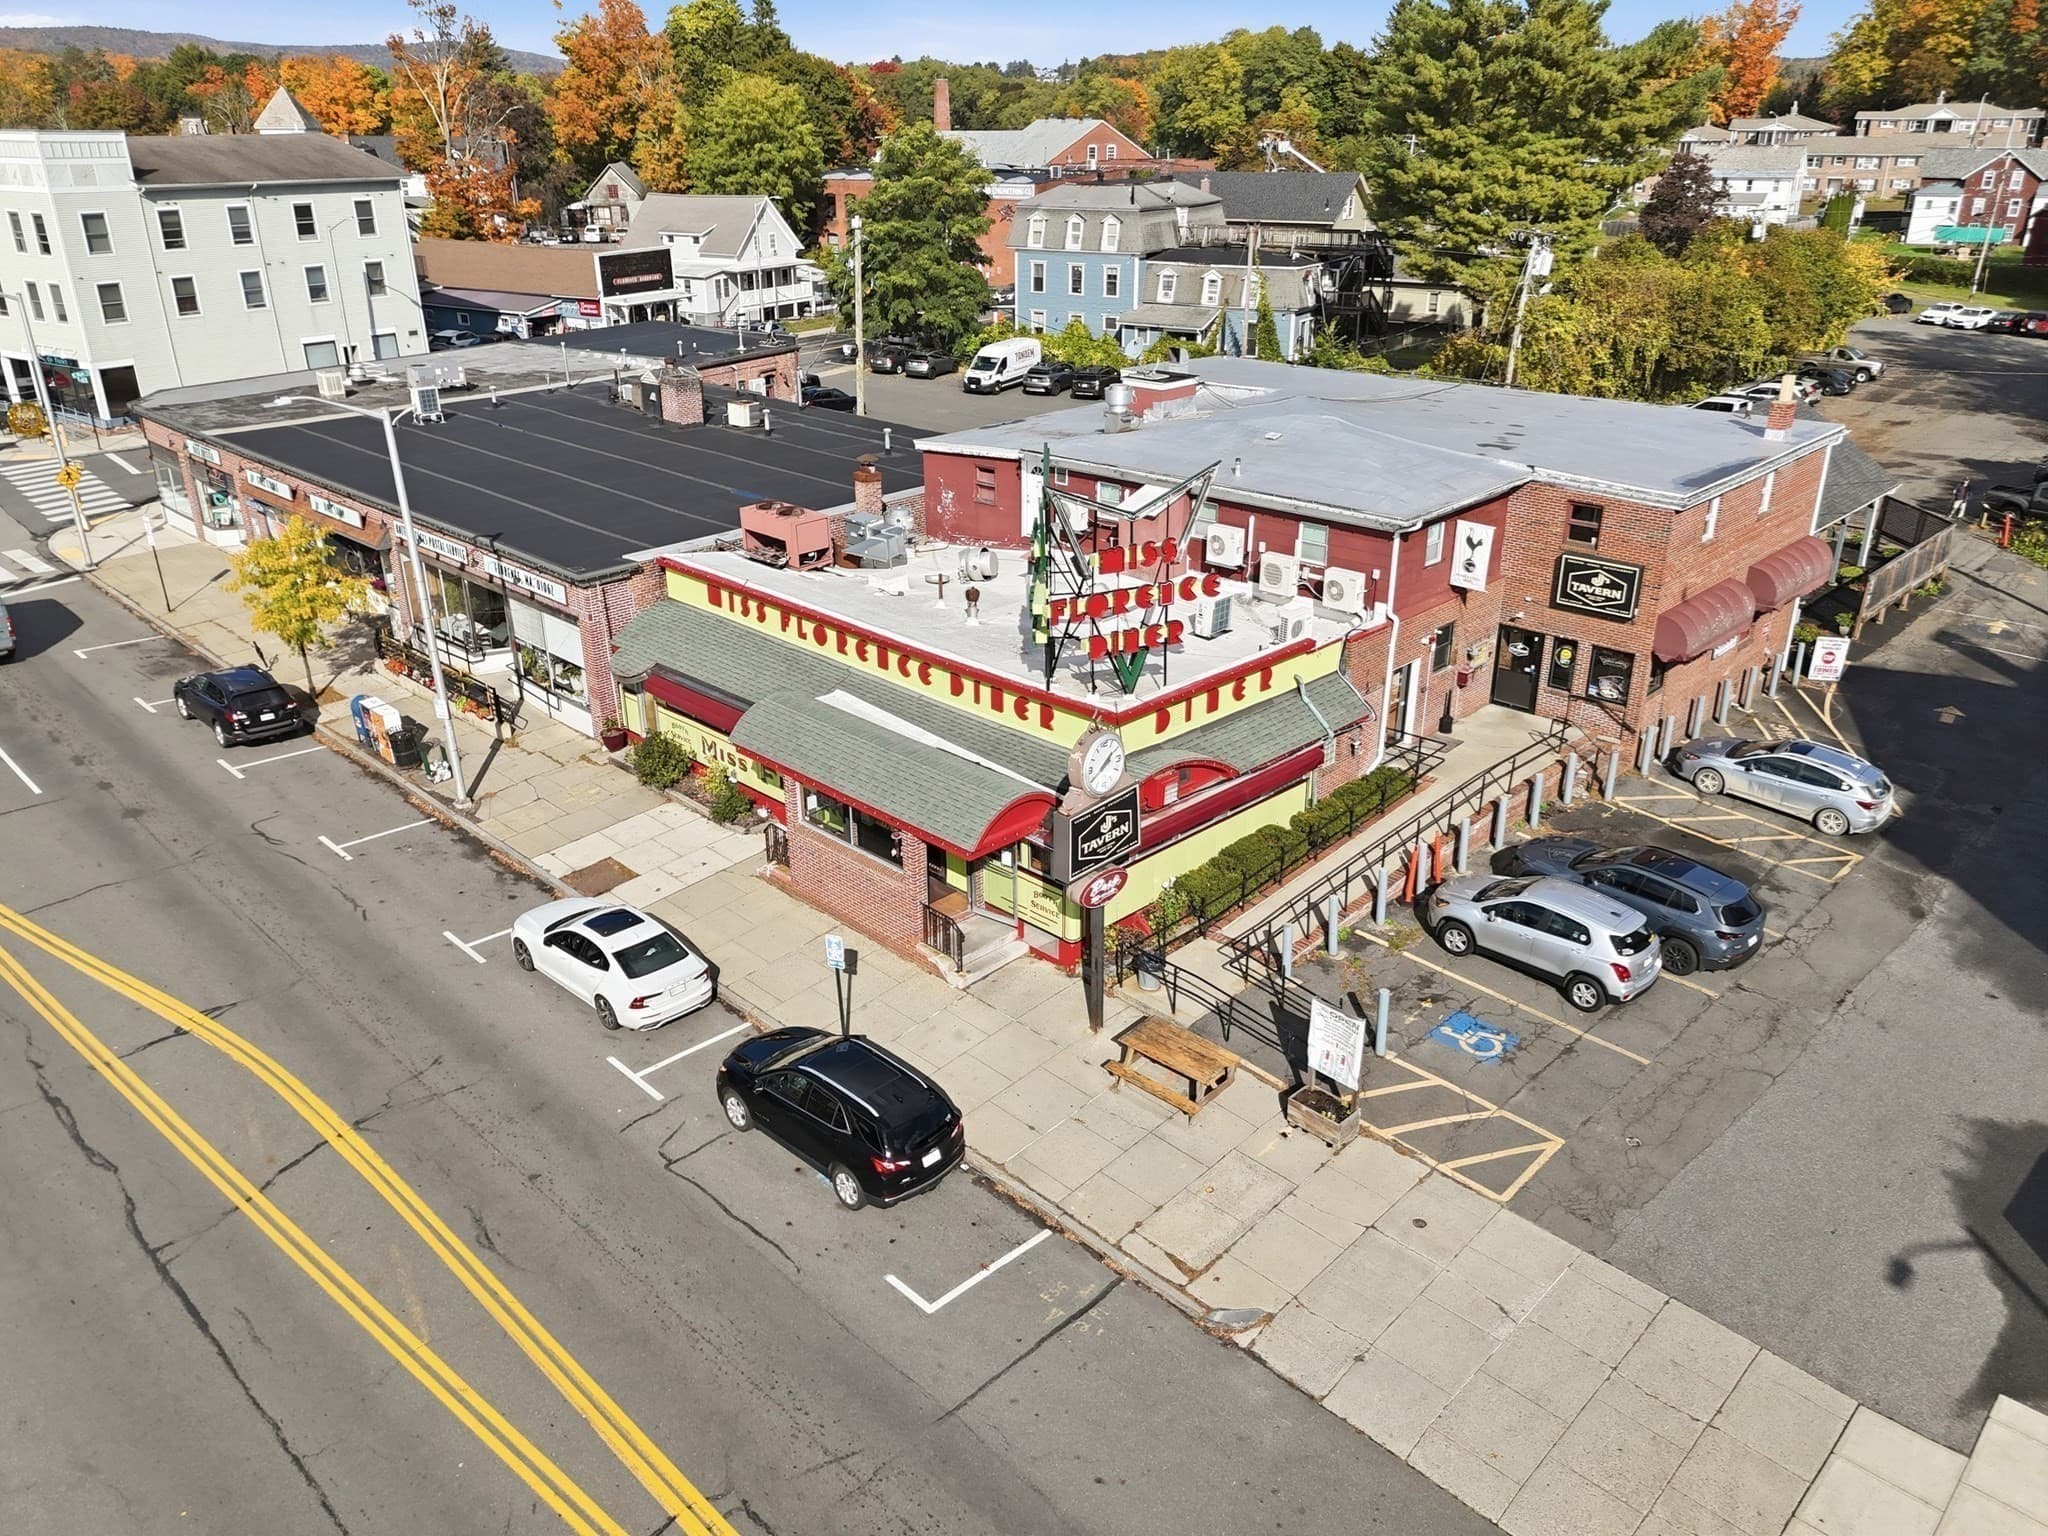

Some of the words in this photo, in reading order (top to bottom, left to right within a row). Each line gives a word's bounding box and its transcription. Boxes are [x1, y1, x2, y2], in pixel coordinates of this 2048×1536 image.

[428, 536, 446, 553] POSTAL
[446, 543, 466, 561] SERVICE
[1099, 537, 1178, 575] MISS
[536, 579, 554, 597] 01062
[1050, 573, 1221, 627] FLORENCE
[1571, 581, 1622, 601] TAVERN
[706, 583, 767, 624] MISS
[780, 611, 933, 687] FLORENCE
[950, 672, 1055, 732] DINER
[1088, 620, 1184, 661] DINER
[1155, 667, 1273, 735] DINER
[1081, 821, 1129, 855] TAVERN
